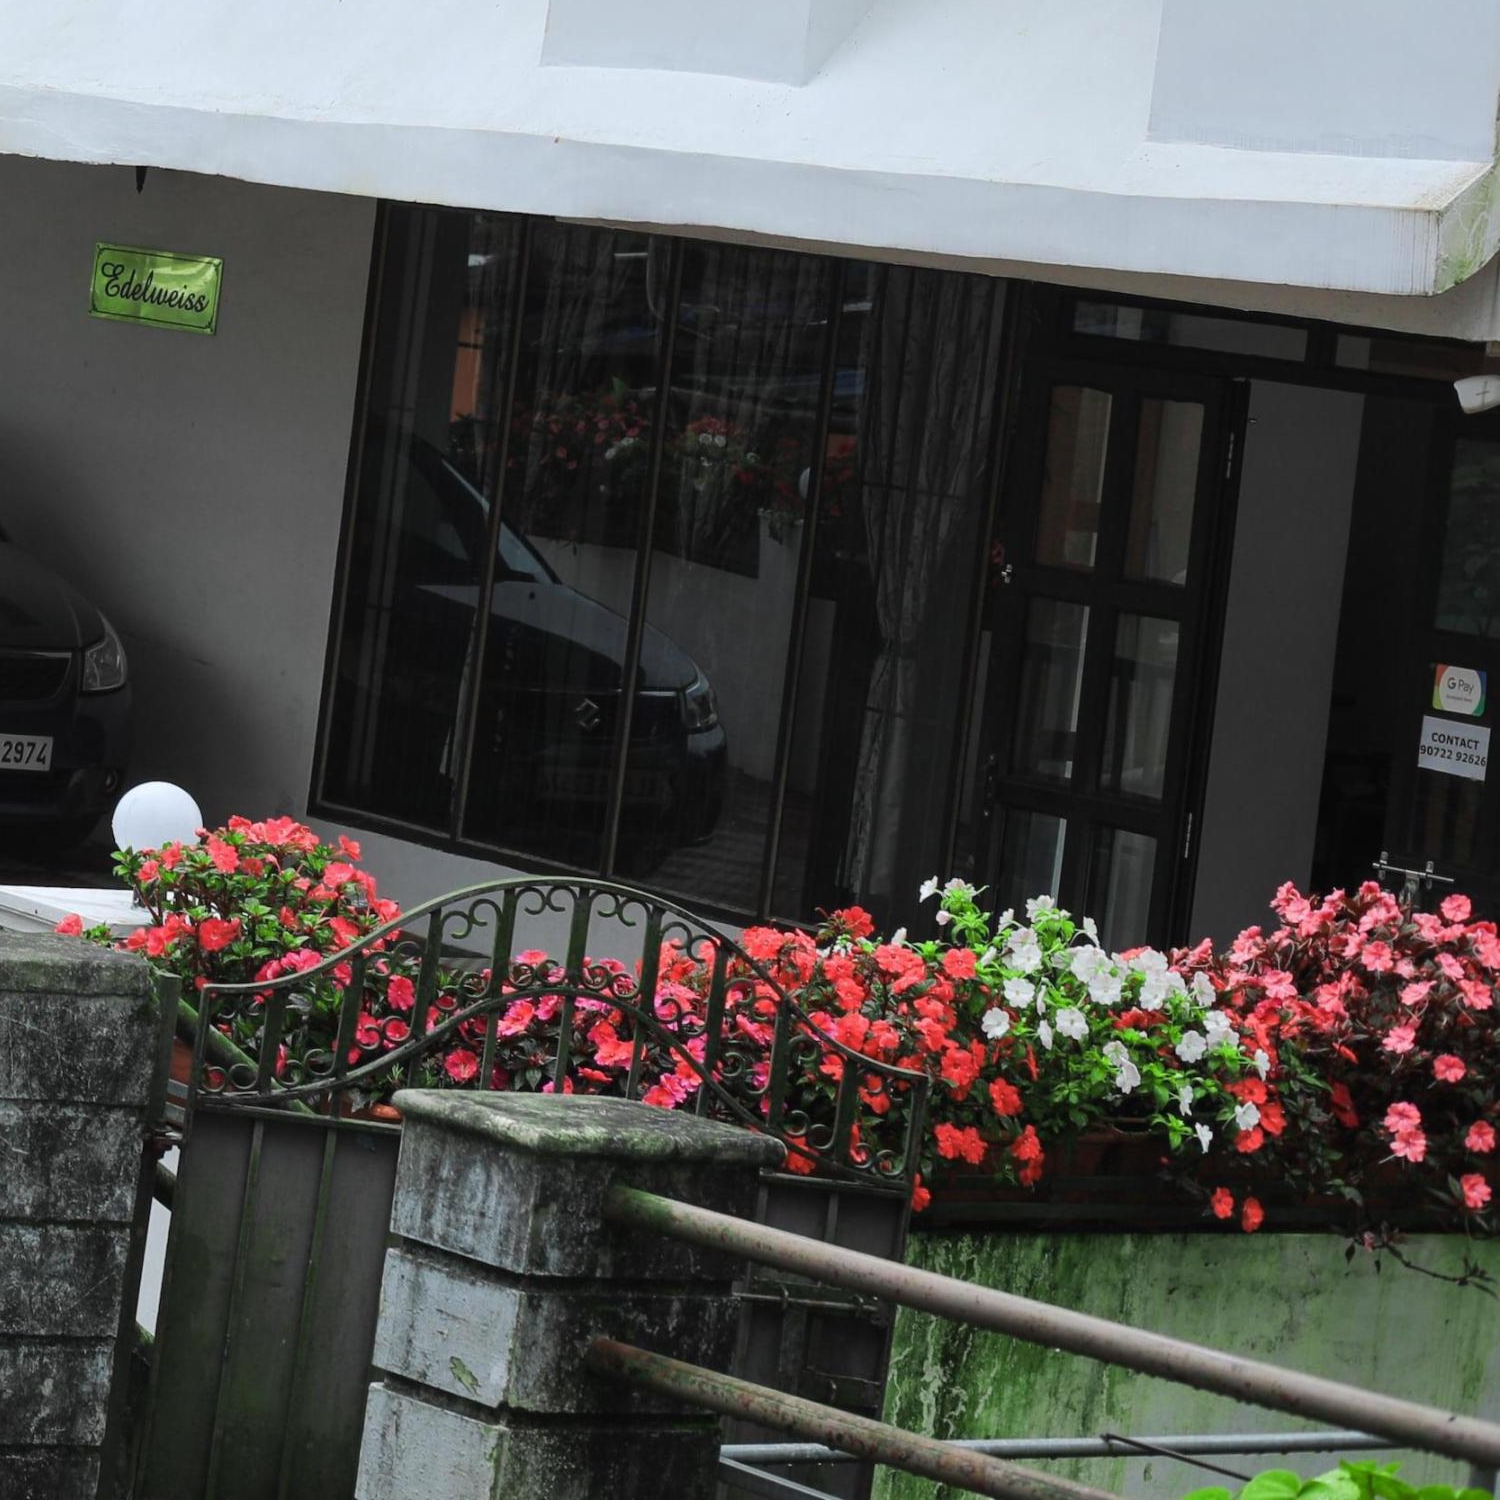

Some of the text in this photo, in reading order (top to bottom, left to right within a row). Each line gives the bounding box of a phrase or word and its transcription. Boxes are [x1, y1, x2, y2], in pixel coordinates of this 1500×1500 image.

[101, 261, 210, 313] Edelweiss
[1458, 679, 1474, 697] Pay
[1, 741, 48, 764] 2974
[1431, 732, 1480, 751] CONTACT
[1420, 744, 1486, 767] 90722 92626
